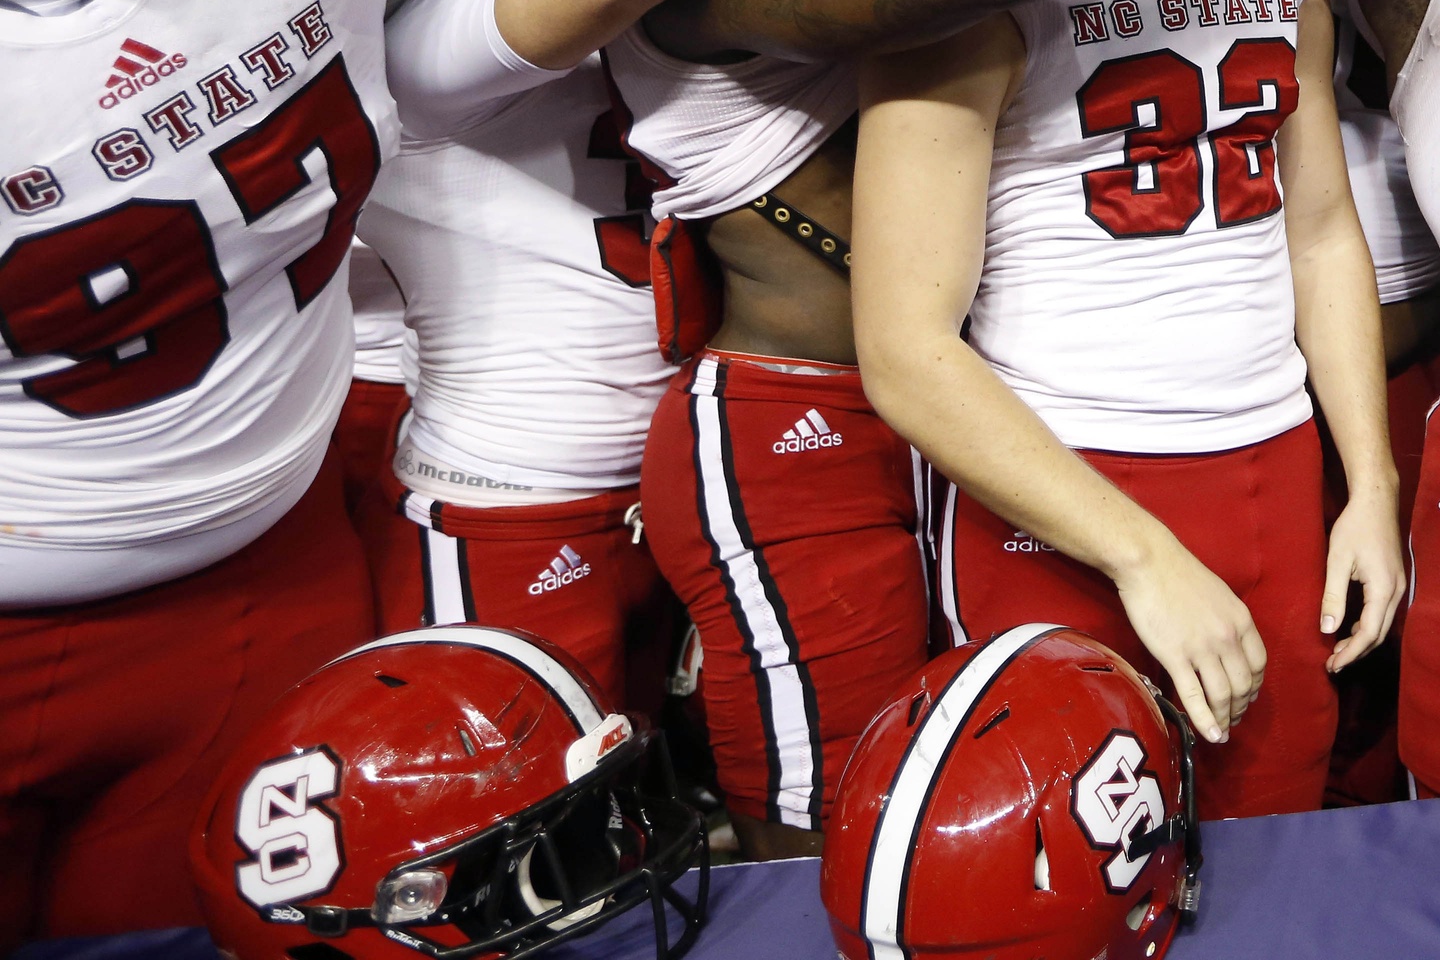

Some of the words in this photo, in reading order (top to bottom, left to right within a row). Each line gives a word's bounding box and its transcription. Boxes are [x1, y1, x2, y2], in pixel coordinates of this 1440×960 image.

[91, 0, 334, 182] STATE
[99, 51, 188, 111] adidas
[1076, 36, 1300, 240] 32
[0, 50, 382, 421] 97
[773, 429, 843, 455] adidas
[528, 562, 592, 596] adidas
[270, 907, 303, 921] 360
